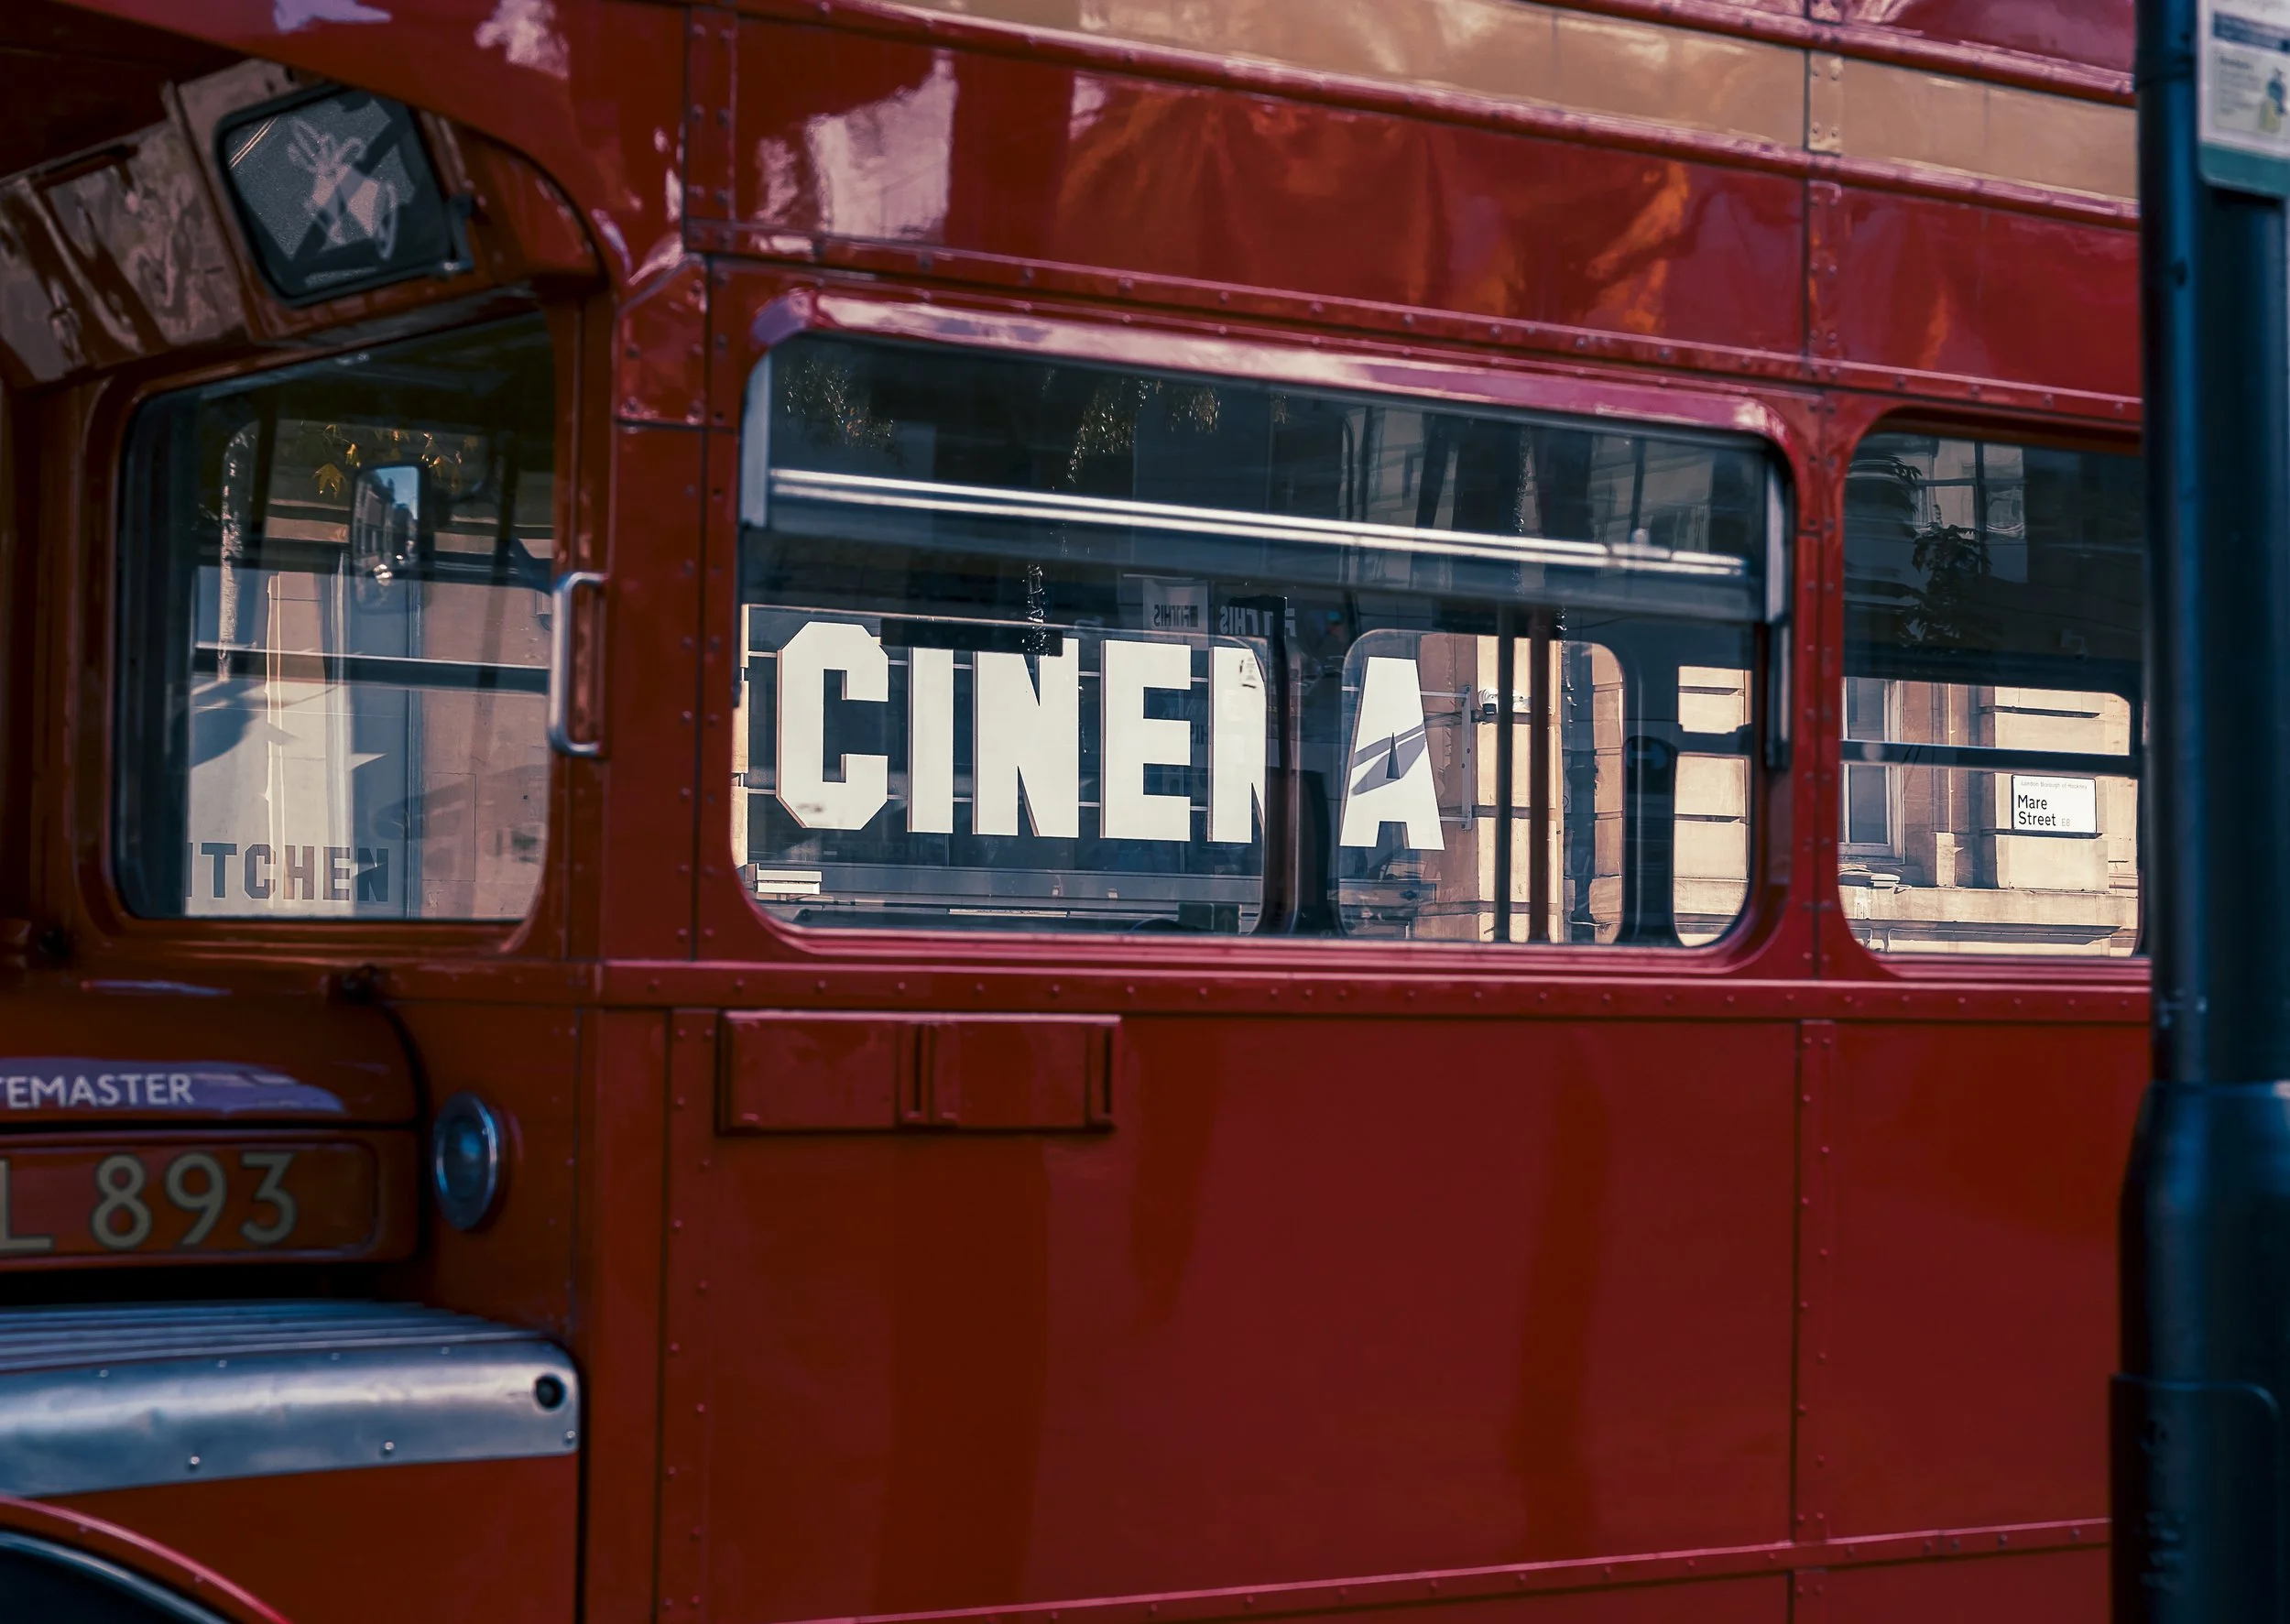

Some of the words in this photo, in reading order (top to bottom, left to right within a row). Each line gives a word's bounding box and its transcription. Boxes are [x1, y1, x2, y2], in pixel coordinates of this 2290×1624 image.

[2017, 794, 2048, 810] Mare
[2018, 811, 2056, 826] Street
[2061, 818, 2071, 827] E8
[0, 1074, 195, 1109] EMASTER
[0, 1158, 55, 1250] L
[91, 1151, 298, 1250] 893
